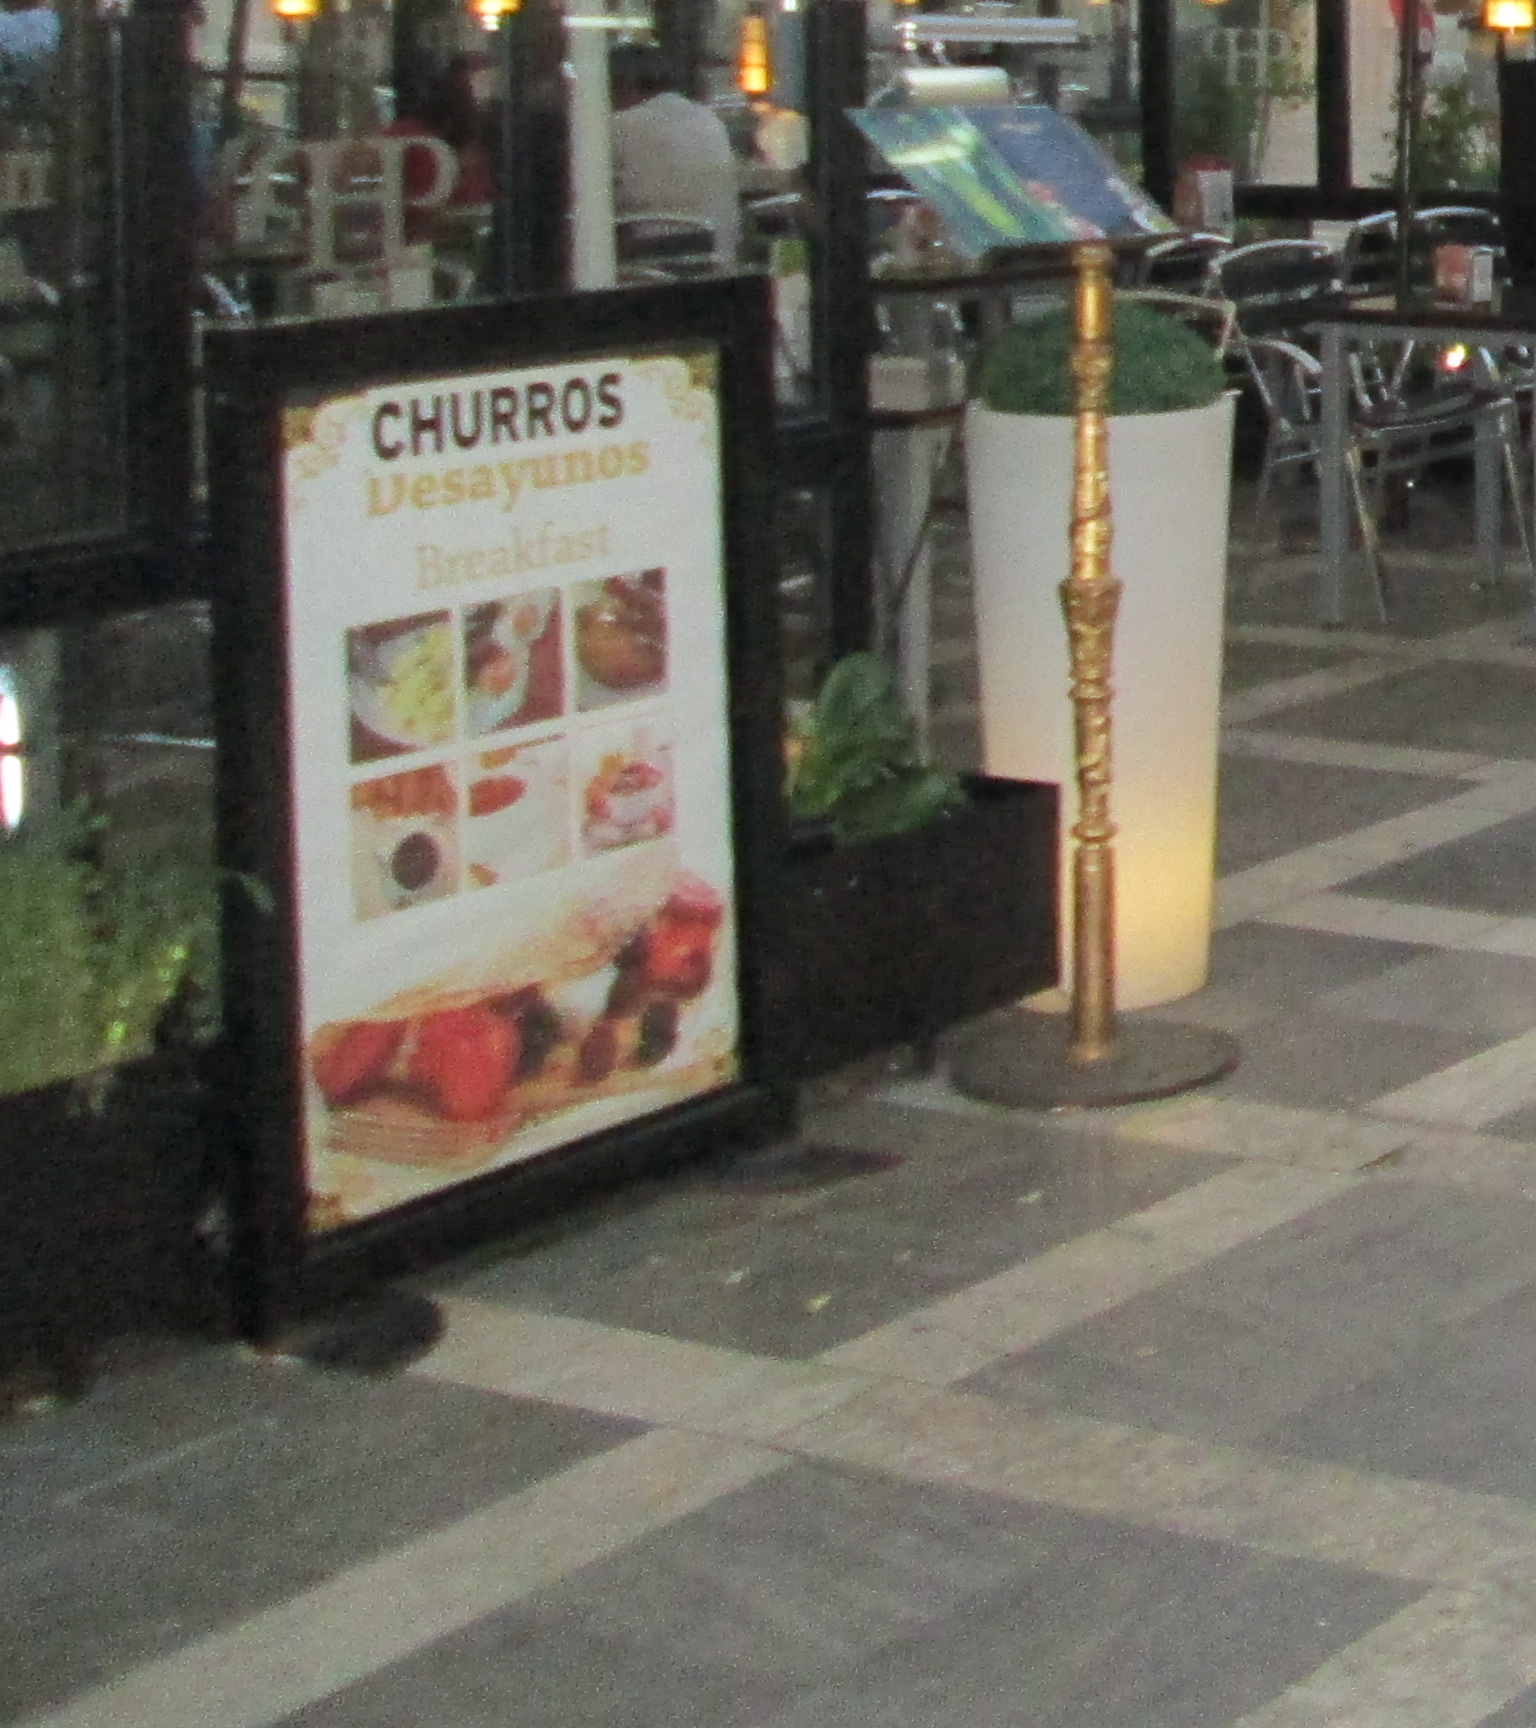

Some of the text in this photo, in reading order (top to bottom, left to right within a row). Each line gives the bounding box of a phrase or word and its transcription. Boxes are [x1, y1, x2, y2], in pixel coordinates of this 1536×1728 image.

[371, 372, 625, 461] CHURROS
[365, 440, 650, 519] Desayunos
[415, 521, 613, 592] Breakfast
